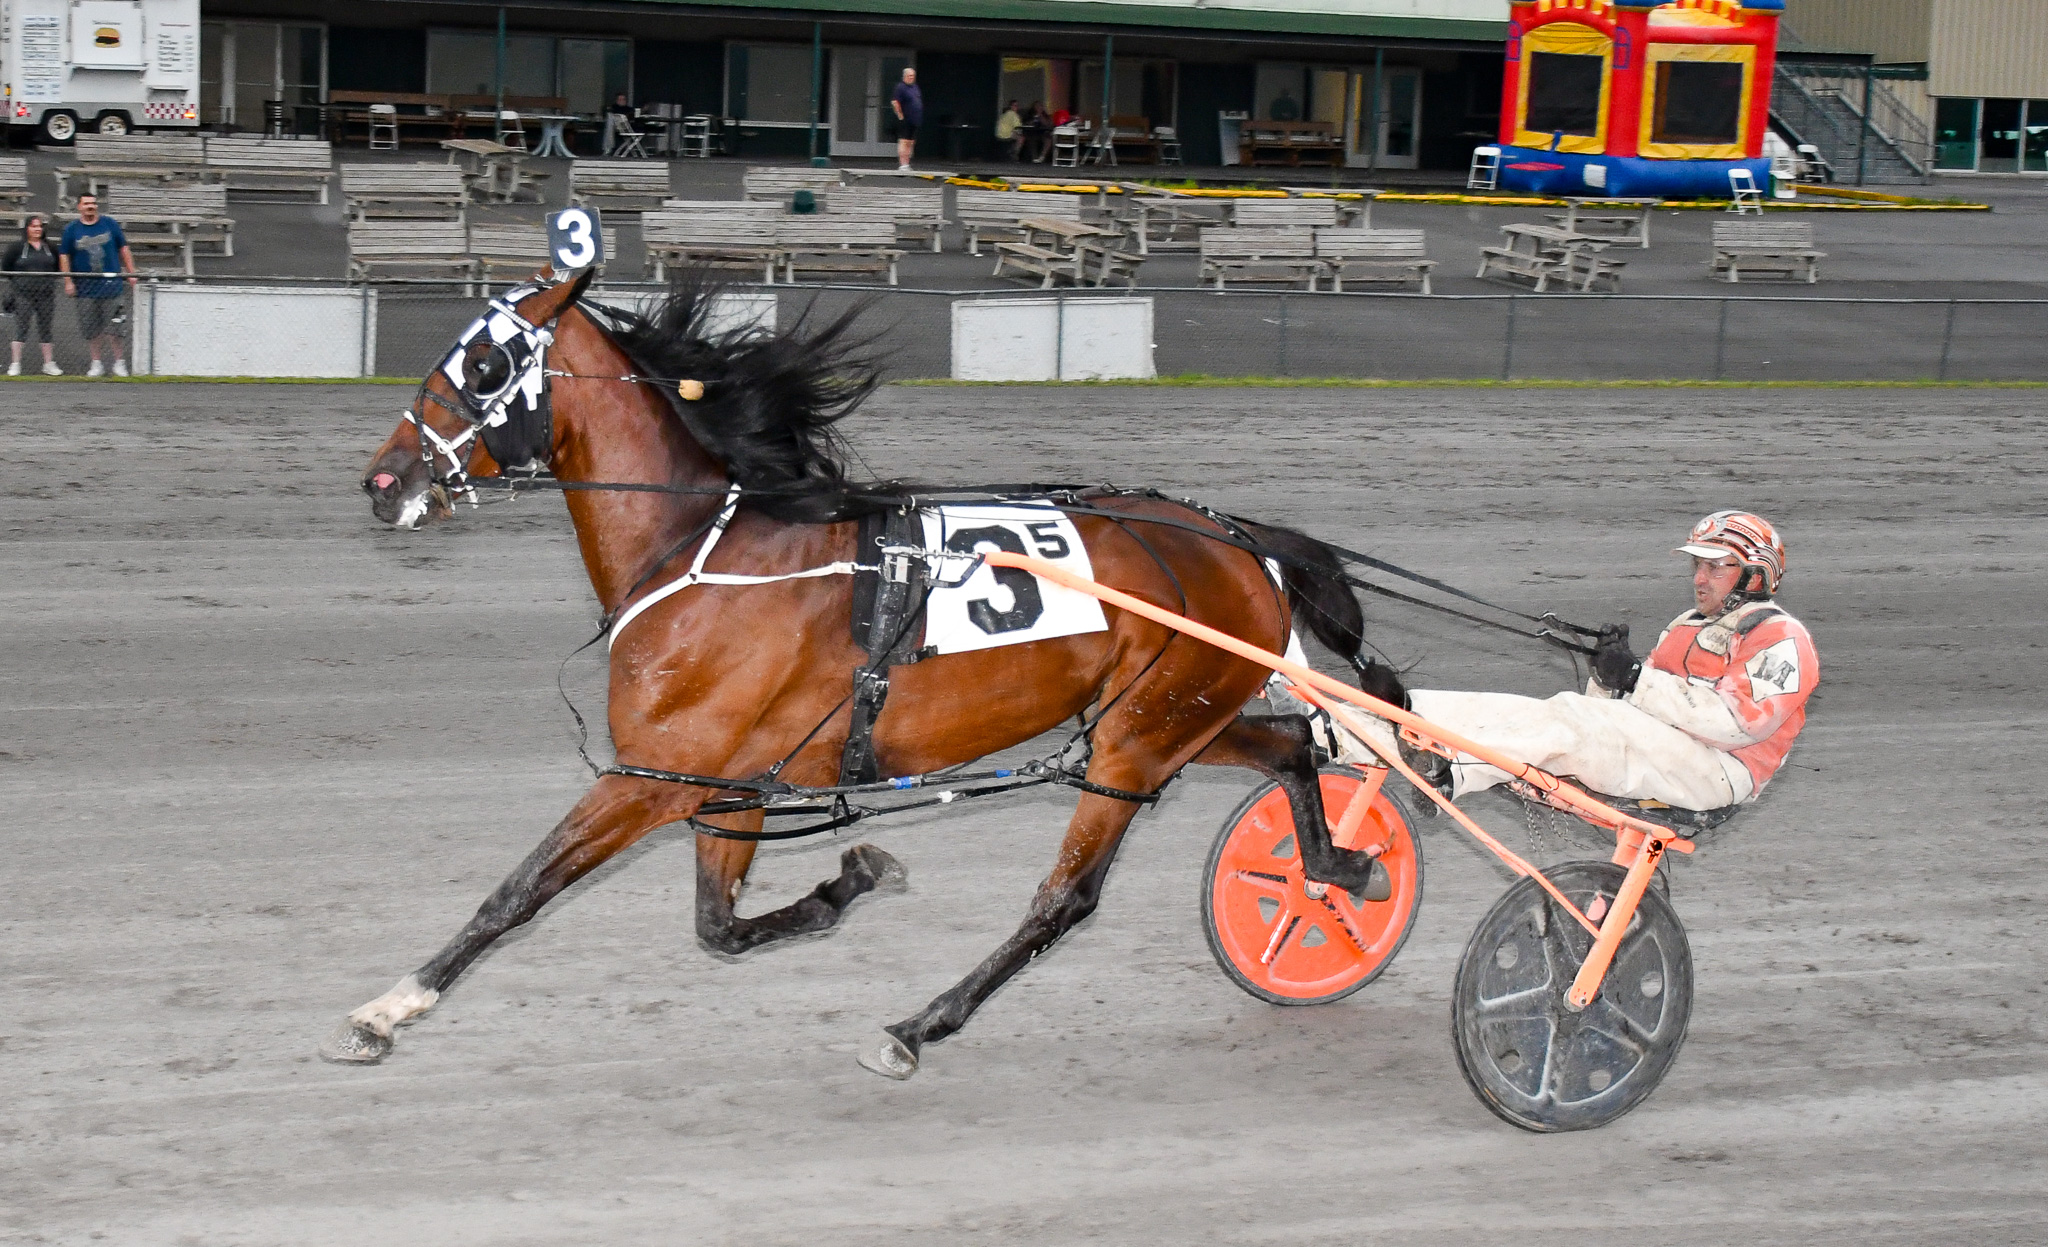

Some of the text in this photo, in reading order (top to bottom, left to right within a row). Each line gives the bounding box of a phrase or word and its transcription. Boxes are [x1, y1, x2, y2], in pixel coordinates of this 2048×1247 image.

[557, 208, 596, 268] 3
[1023, 520, 1071, 560] 5
[946, 524, 1044, 635] 3
[1752, 651, 1796, 691] M
